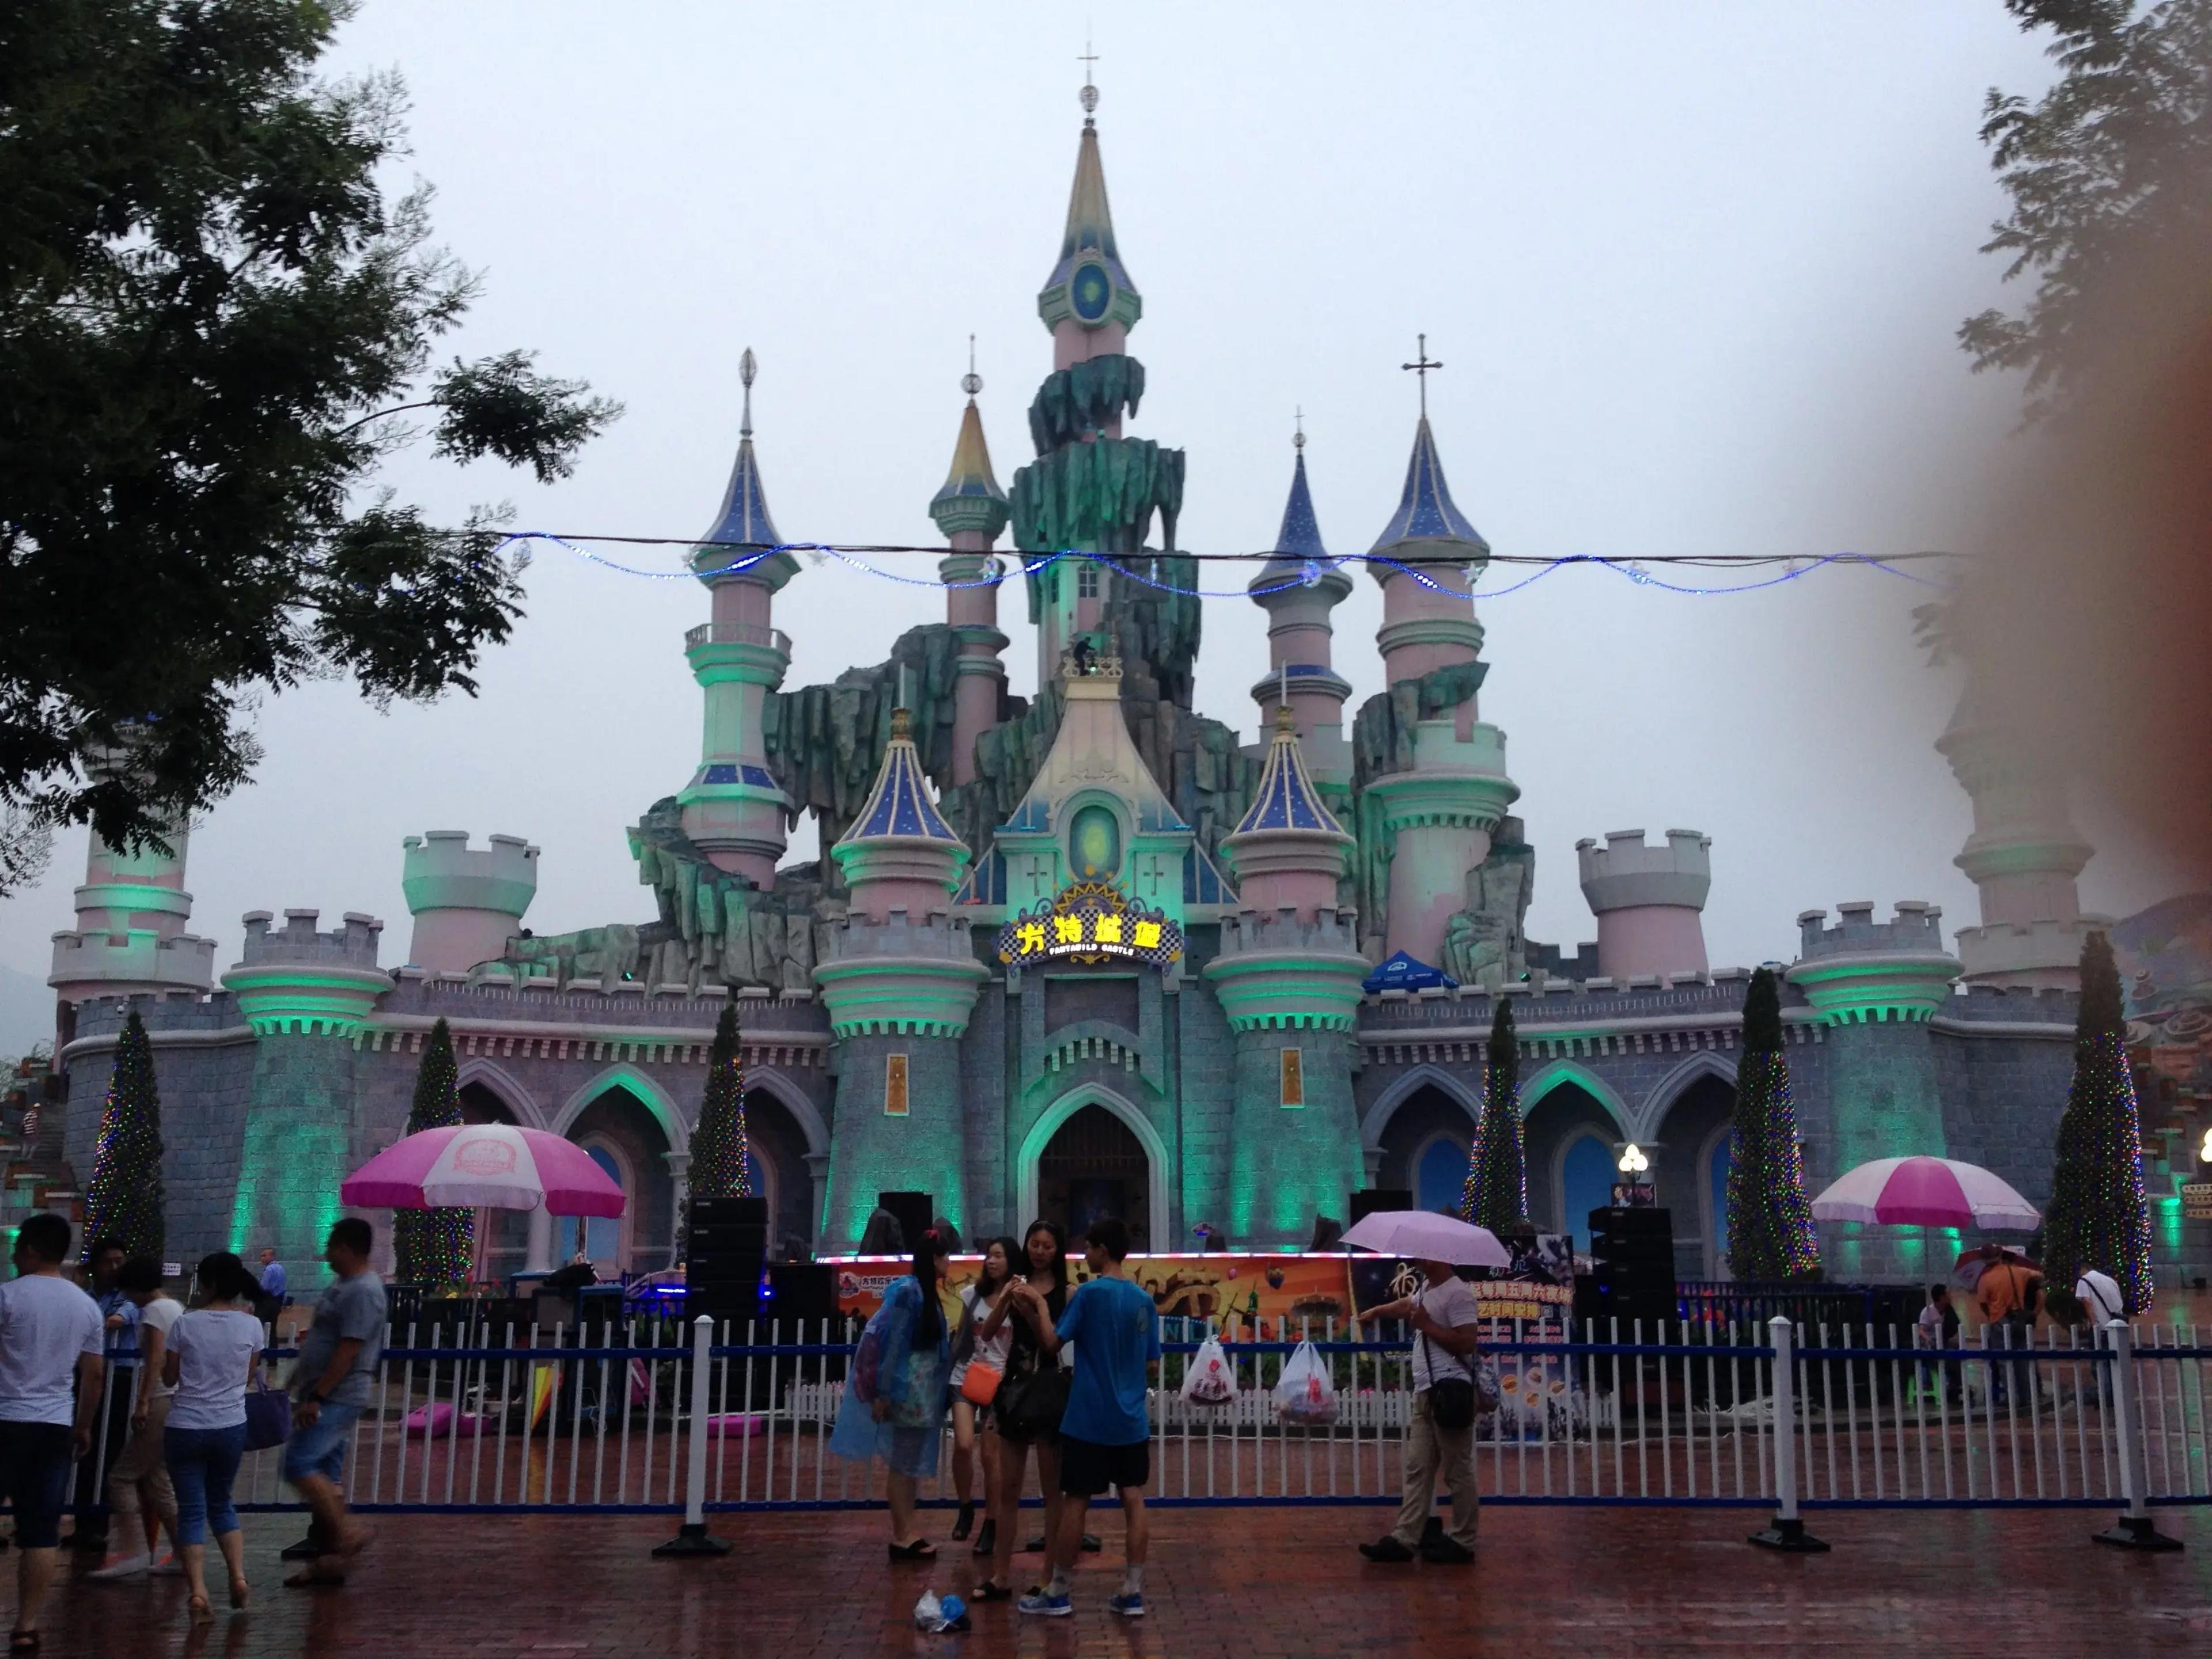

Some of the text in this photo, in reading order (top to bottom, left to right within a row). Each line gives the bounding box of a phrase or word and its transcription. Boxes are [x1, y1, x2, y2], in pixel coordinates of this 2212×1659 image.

[1017, 913, 1161, 955] 方特城堡
[1049, 944, 1134, 956] FANTAWILD CASTLE
[862, 1277, 899, 1285] 方特欢乐
